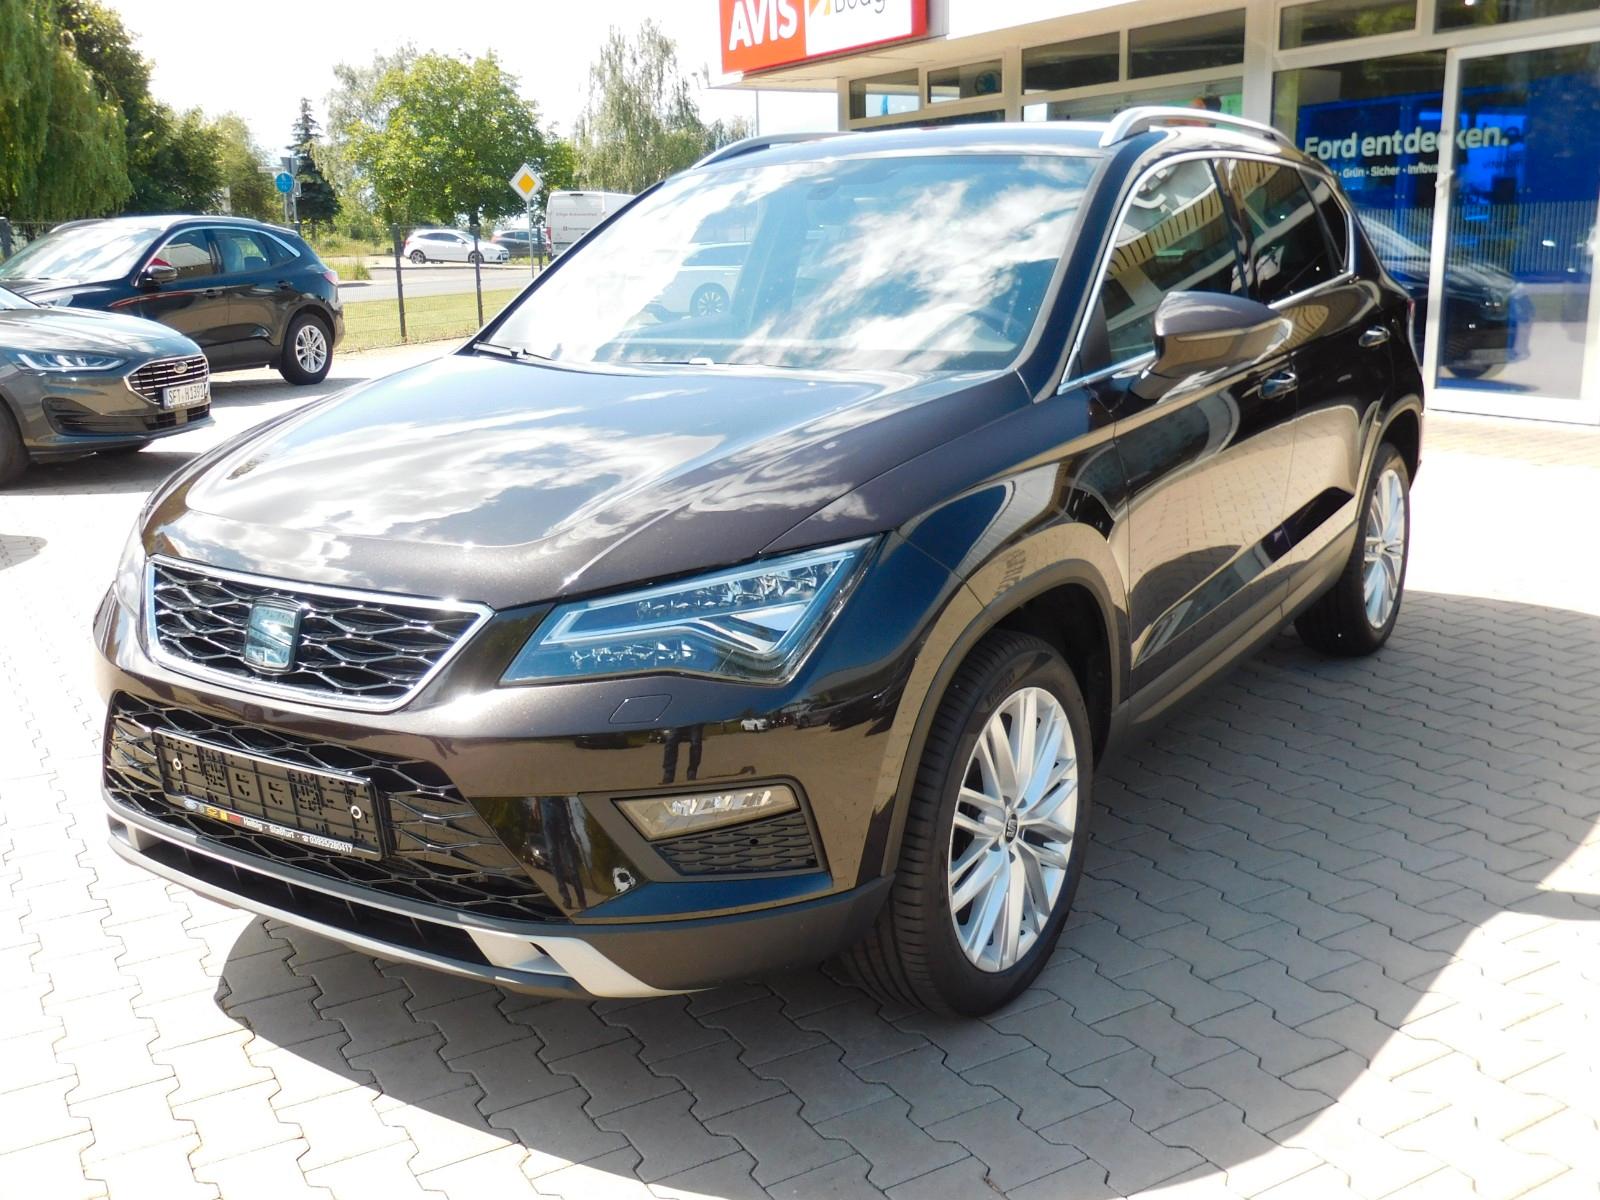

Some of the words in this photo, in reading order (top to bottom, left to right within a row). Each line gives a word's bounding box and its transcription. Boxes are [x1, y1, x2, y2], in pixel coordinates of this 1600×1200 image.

[729, 0, 798, 51] AVIS
[1305, 132, 1356, 160] Ford
[1361, 126, 1508, 156] entdeken.
[1343, 167, 1365, 178] Grün
[1370, 164, 1400, 177] Sicher
[1407, 162, 1438, 175] Innova
